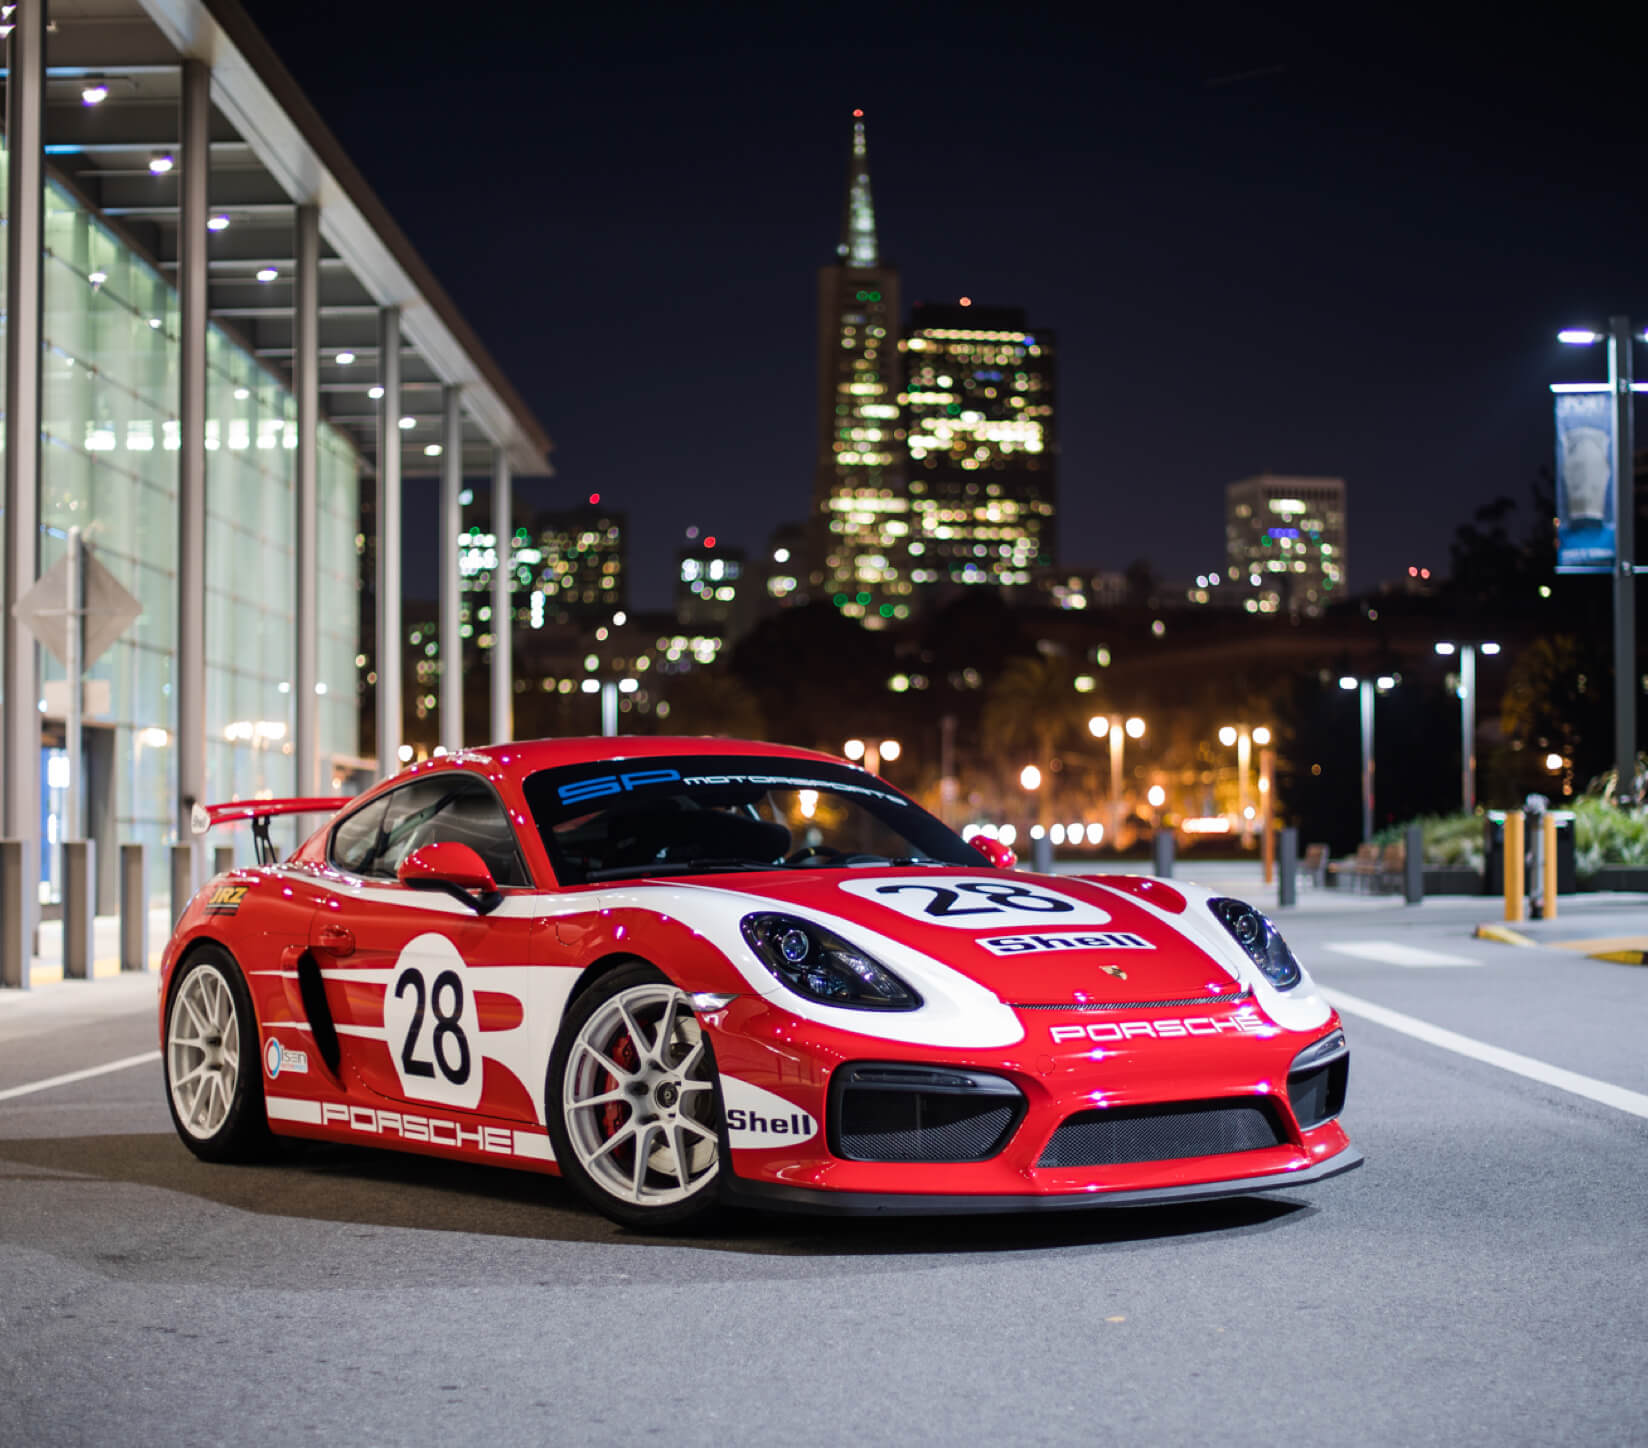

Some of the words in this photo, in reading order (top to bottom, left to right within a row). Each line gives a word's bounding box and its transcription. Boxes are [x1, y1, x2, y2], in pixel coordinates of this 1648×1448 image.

[558, 769, 680, 806] SP
[876, 882, 1075, 917] 28
[987, 934, 1146, 953] Shell
[394, 967, 471, 1086] 28
[1050, 1015, 1265, 1044] PORSCHE
[321, 1102, 512, 1155] PORSCHE
[727, 1109, 811, 1135] Shell
